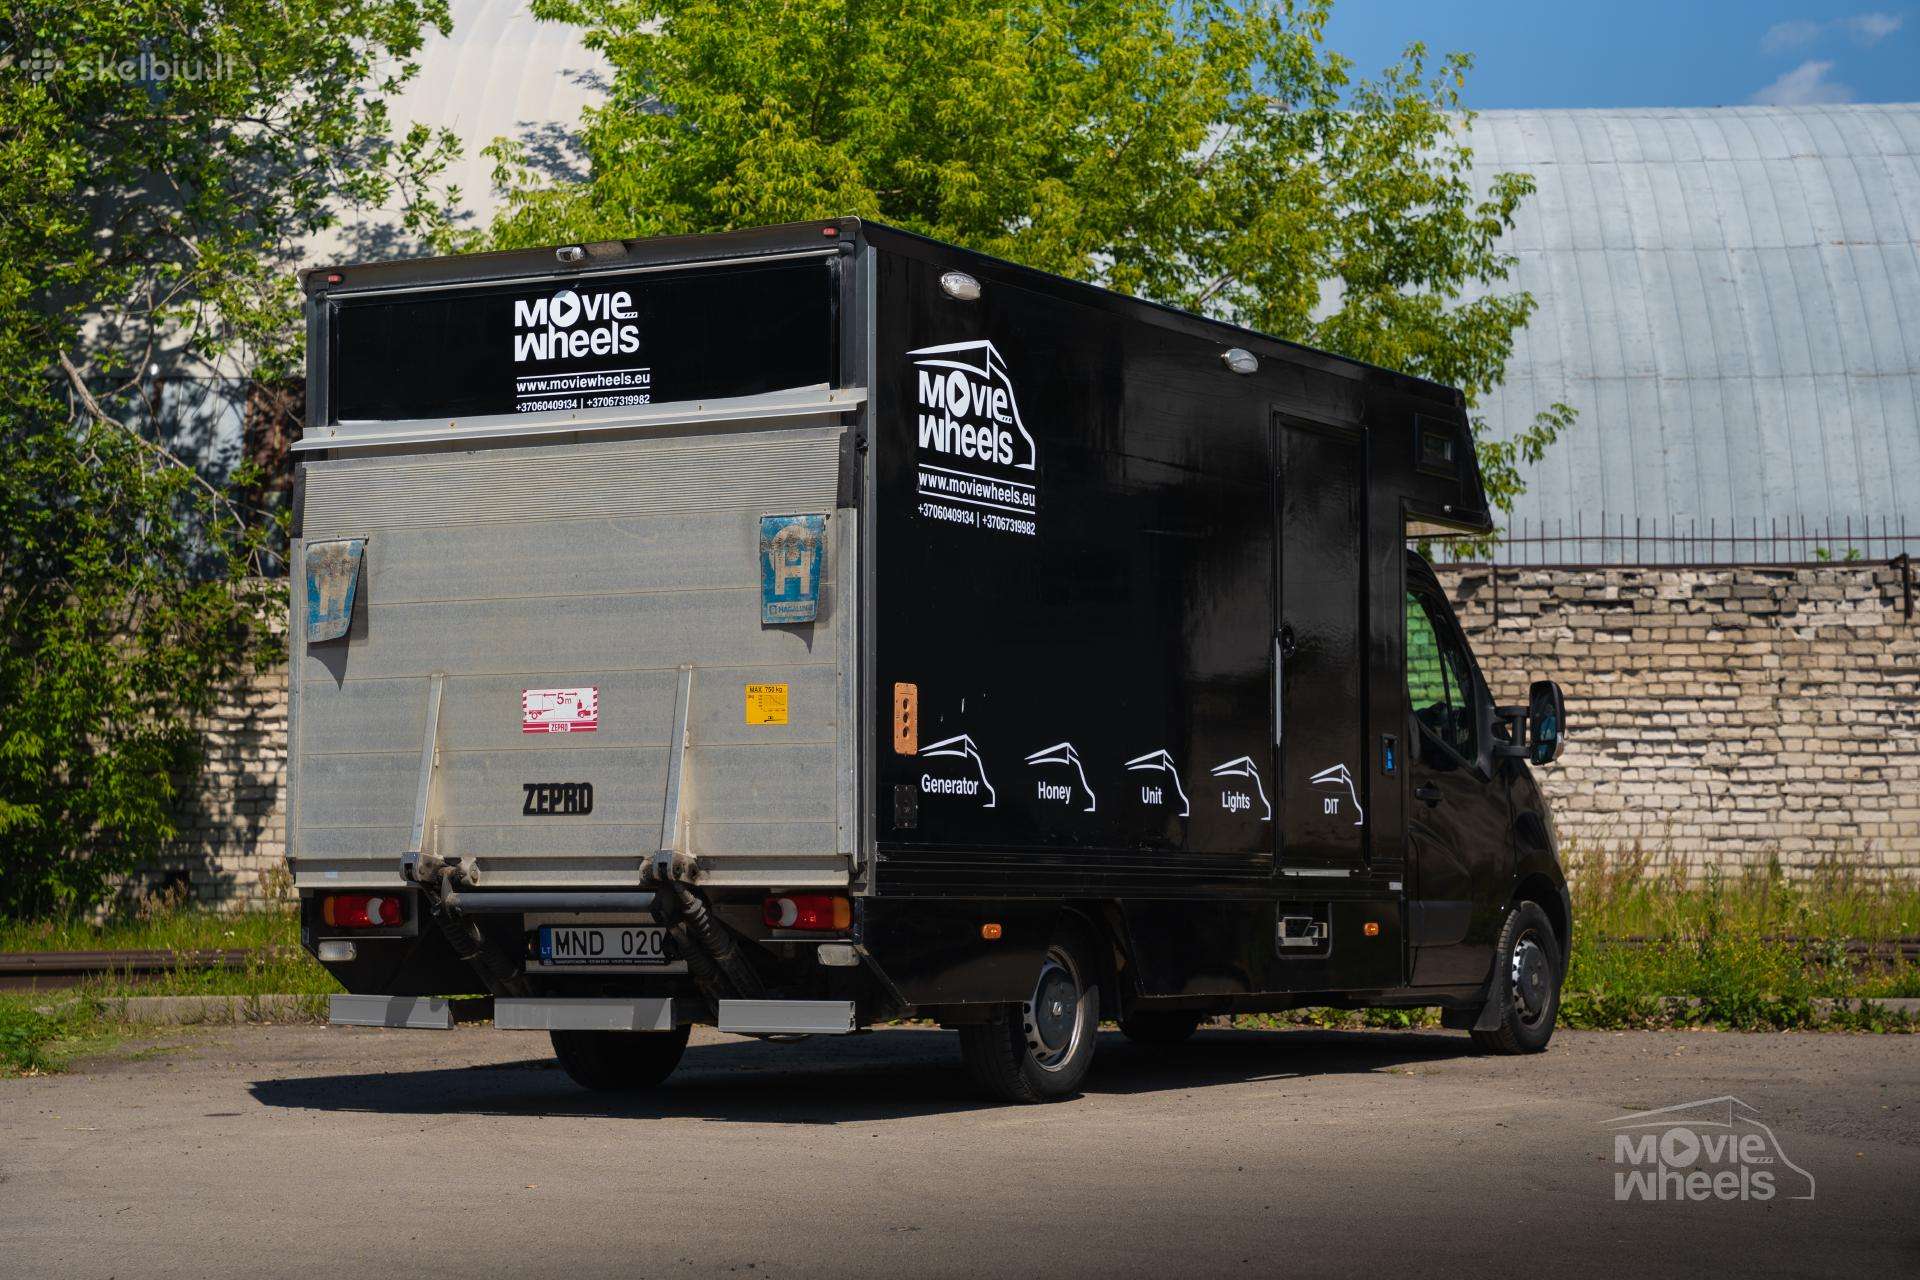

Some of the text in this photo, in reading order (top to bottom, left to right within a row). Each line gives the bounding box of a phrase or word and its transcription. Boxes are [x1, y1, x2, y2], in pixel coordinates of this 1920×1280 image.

[516, 373, 651, 392] www.moviewheels.eu
[516, 399, 578, 412] +37060409134
[586, 394, 650, 408] +37067319982
[918, 471, 1036, 507] www.moviewheels.eu
[918, 502, 975, 525] +37060409134
[982, 512, 1036, 536] +37067319982
[557, 692, 565, 705] 5
[921, 773, 979, 796] Generator
[1038, 780, 1072, 805] Honey
[1141, 786, 1163, 805] Unit
[522, 782, 594, 817] ZEPRO
[1221, 790, 1251, 814] Lights
[1324, 798, 1340, 815] DIT
[541, 946, 551, 955] LT
[555, 930, 664, 955] MND 020
